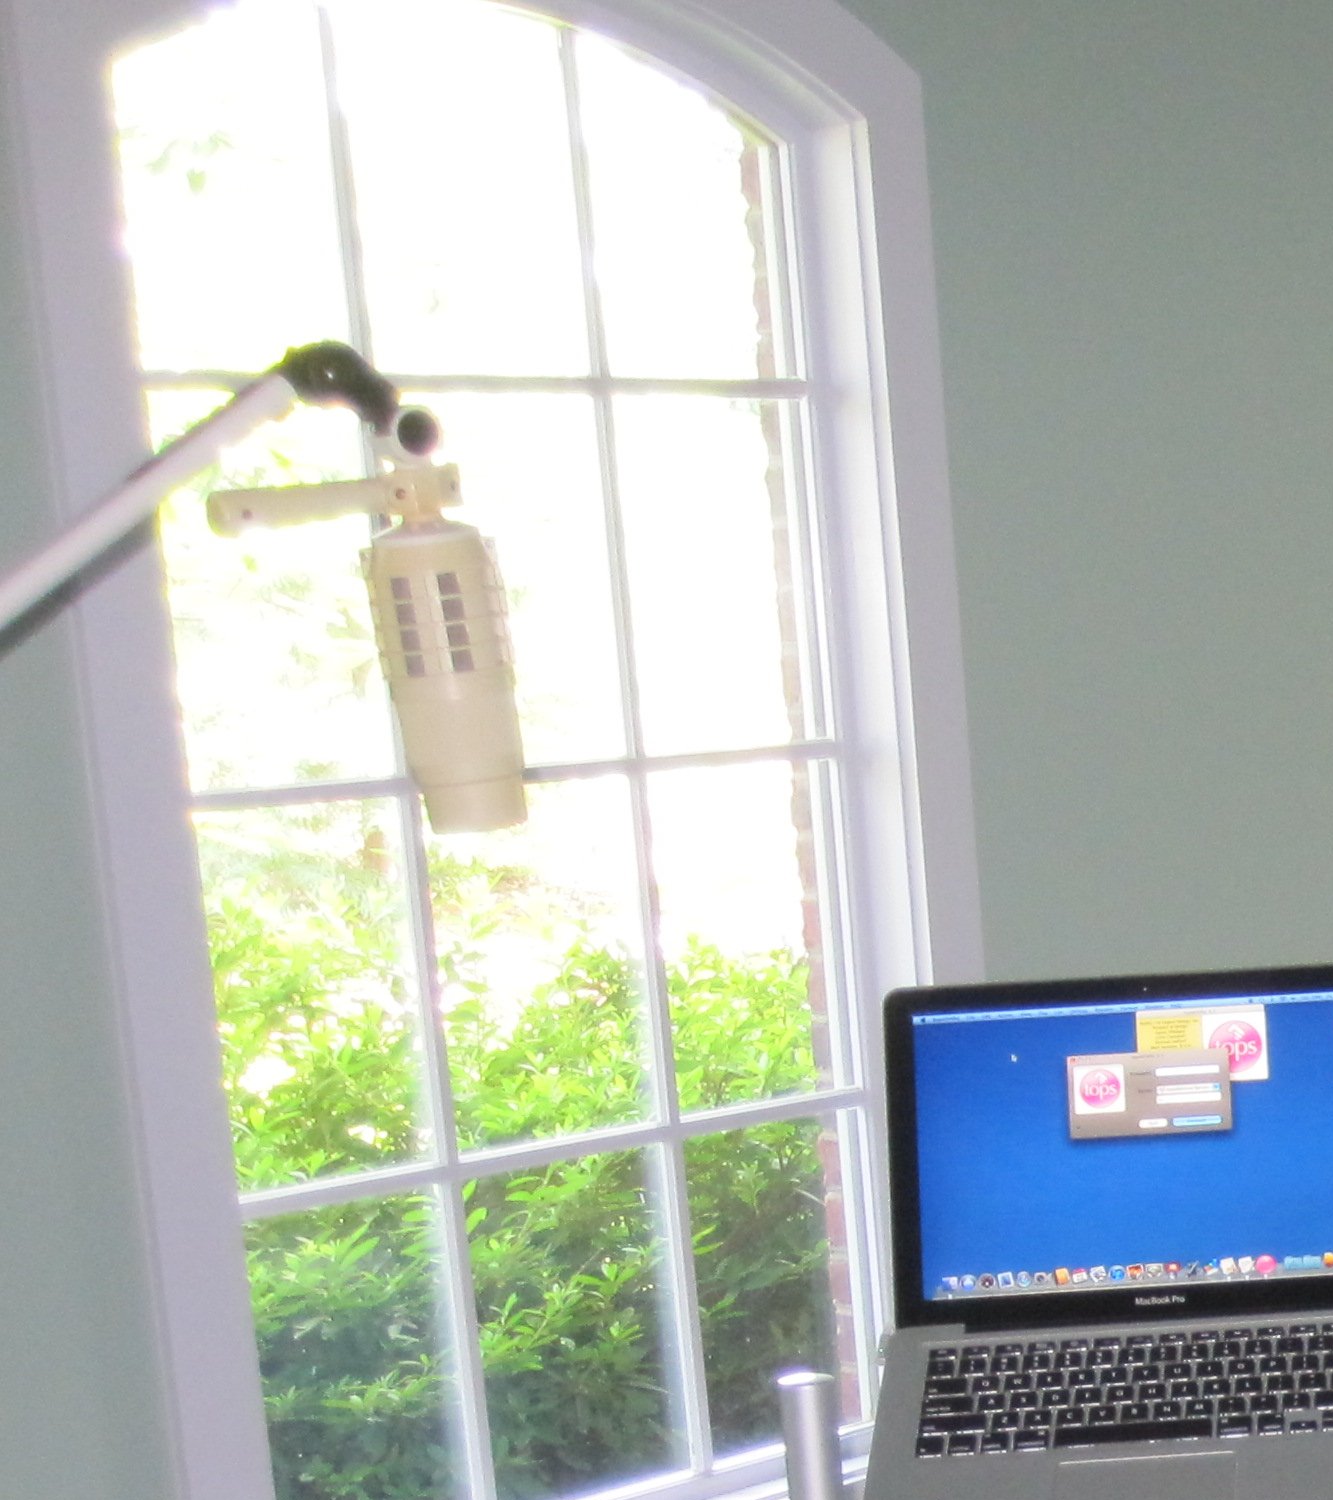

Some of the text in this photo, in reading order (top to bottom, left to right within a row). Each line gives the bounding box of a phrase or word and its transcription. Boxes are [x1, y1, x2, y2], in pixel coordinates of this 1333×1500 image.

[1084, 1083, 1117, 1100] tops
[1135, 1295, 1186, 1305] MacBook Pro
